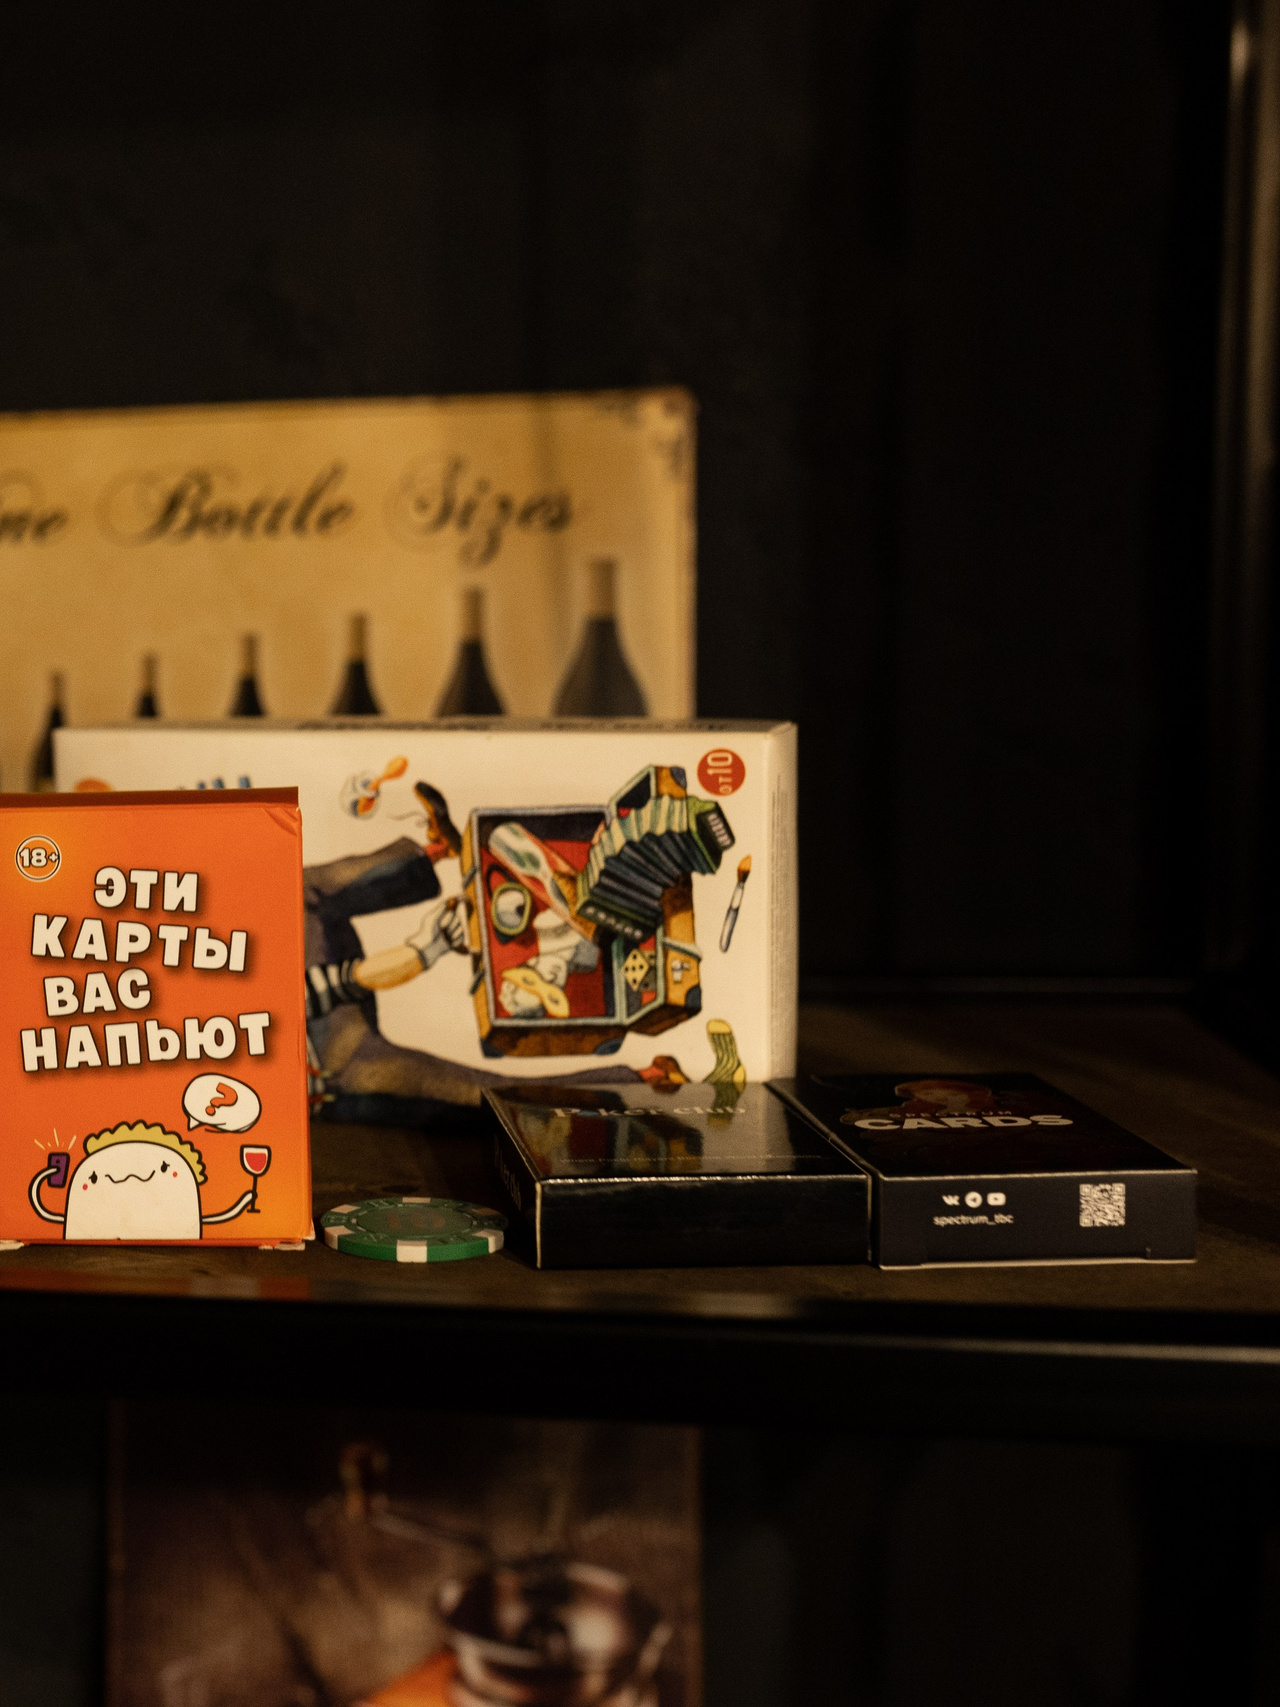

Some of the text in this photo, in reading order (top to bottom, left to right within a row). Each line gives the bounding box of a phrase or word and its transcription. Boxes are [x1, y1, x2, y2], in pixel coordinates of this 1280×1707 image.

[96, 463, 354, 547] Bottle
[385, 452, 576, 570] Sizes
[19, 846, 60, 868] 18+
[93, 866, 199, 912] ЭТИ
[31, 913, 248, 973] КАРТЫ
[43, 967, 152, 1017] ВАС
[20, 1011, 272, 1073] НАПЬЮТ
[854, 1114, 1074, 1131] CARDS
